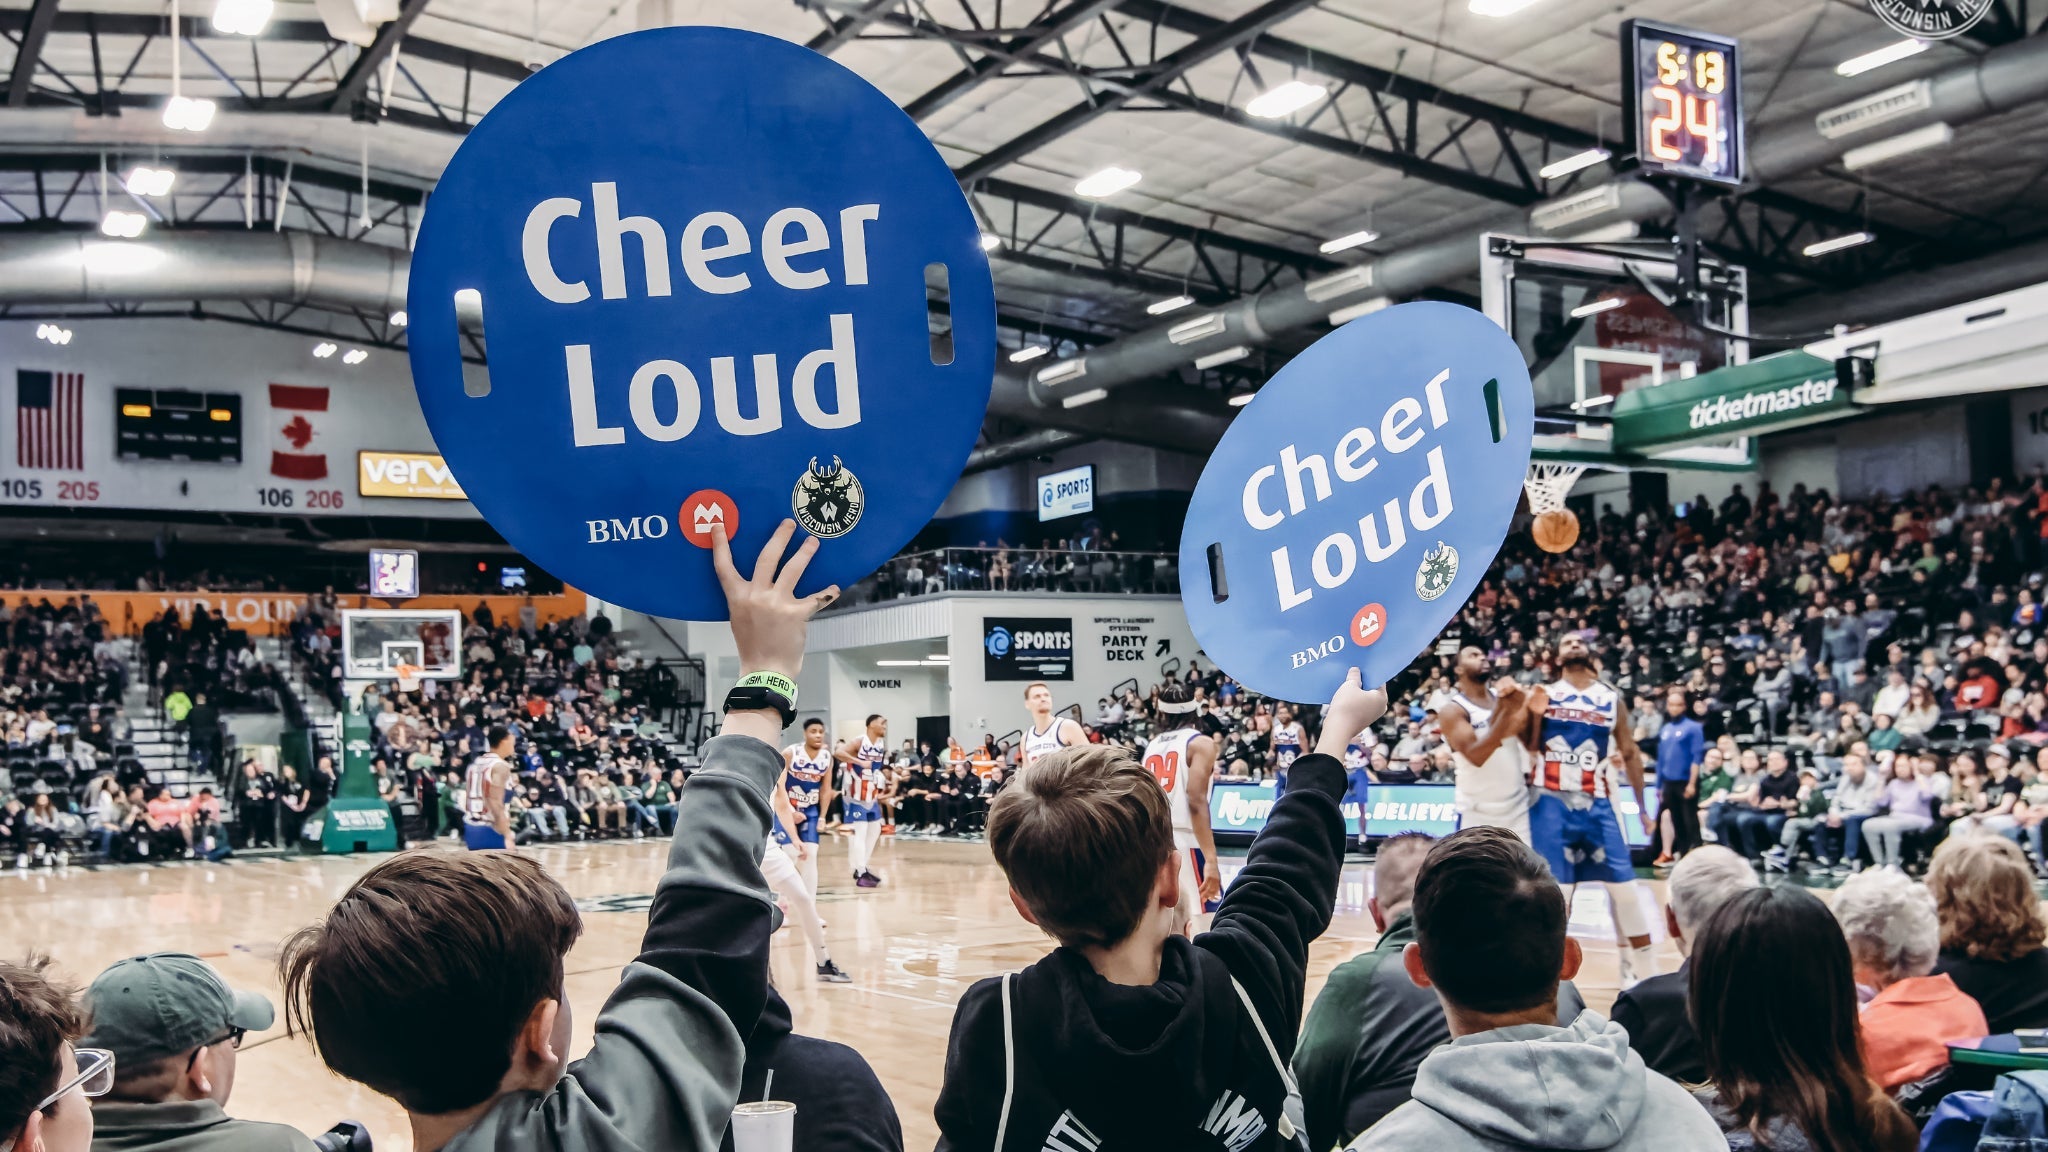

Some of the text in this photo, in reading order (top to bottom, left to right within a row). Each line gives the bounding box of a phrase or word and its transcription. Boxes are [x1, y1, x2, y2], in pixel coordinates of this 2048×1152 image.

[1657, 42, 1725, 94] 5:13
[1651, 85, 1719, 163] 24
[522, 181, 880, 303] Cheer
[565, 313, 861, 447] Loud
[1689, 378, 1839, 429] ticketmaster
[1242, 367, 1450, 530] Cheer
[2, 479, 100, 501] 105 205
[258, 488, 344, 508] 106 206
[1057, 477, 1089, 499] SPORTS
[586, 515, 669, 543] BMO
[798, 502, 860, 534] WISCONSIN HERD
[1271, 445, 1454, 612] Loud
[1015, 631, 1071, 649] SPORTS
[1102, 635, 1148, 647] PARTY
[1291, 635, 1345, 669] BMO
[1106, 650, 1144, 661] DECK
[766, 675, 790, 692] HERD
[858, 680, 902, 689] WOMEN
